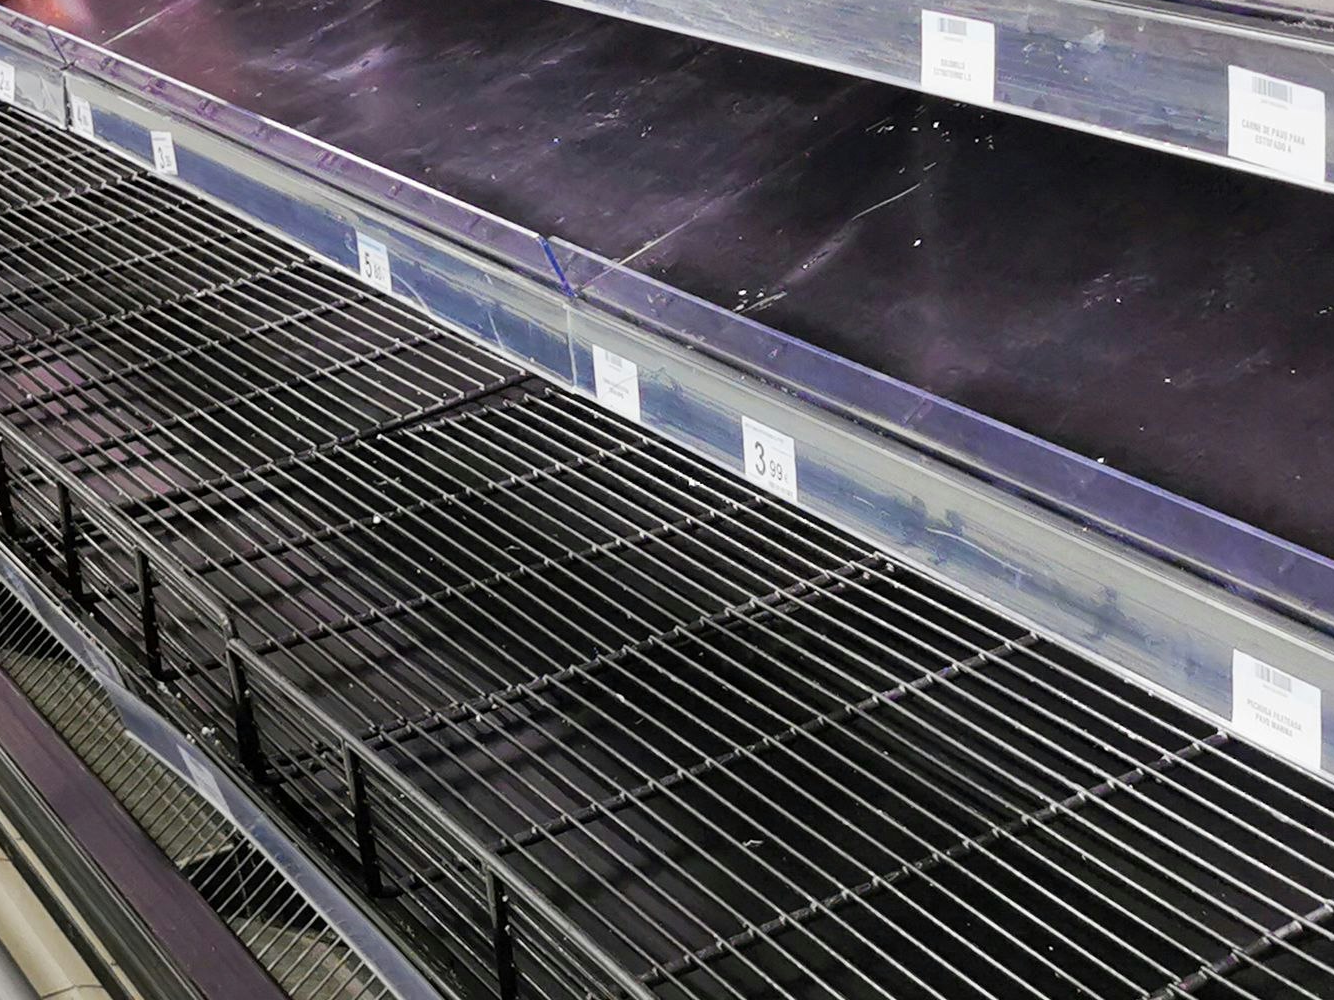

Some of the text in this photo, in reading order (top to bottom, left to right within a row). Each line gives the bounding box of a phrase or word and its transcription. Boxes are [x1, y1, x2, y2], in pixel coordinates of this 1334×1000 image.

[364, 251, 373, 278] 5
[755, 441, 766, 476] 3
[770, 459, 783, 481] 99
